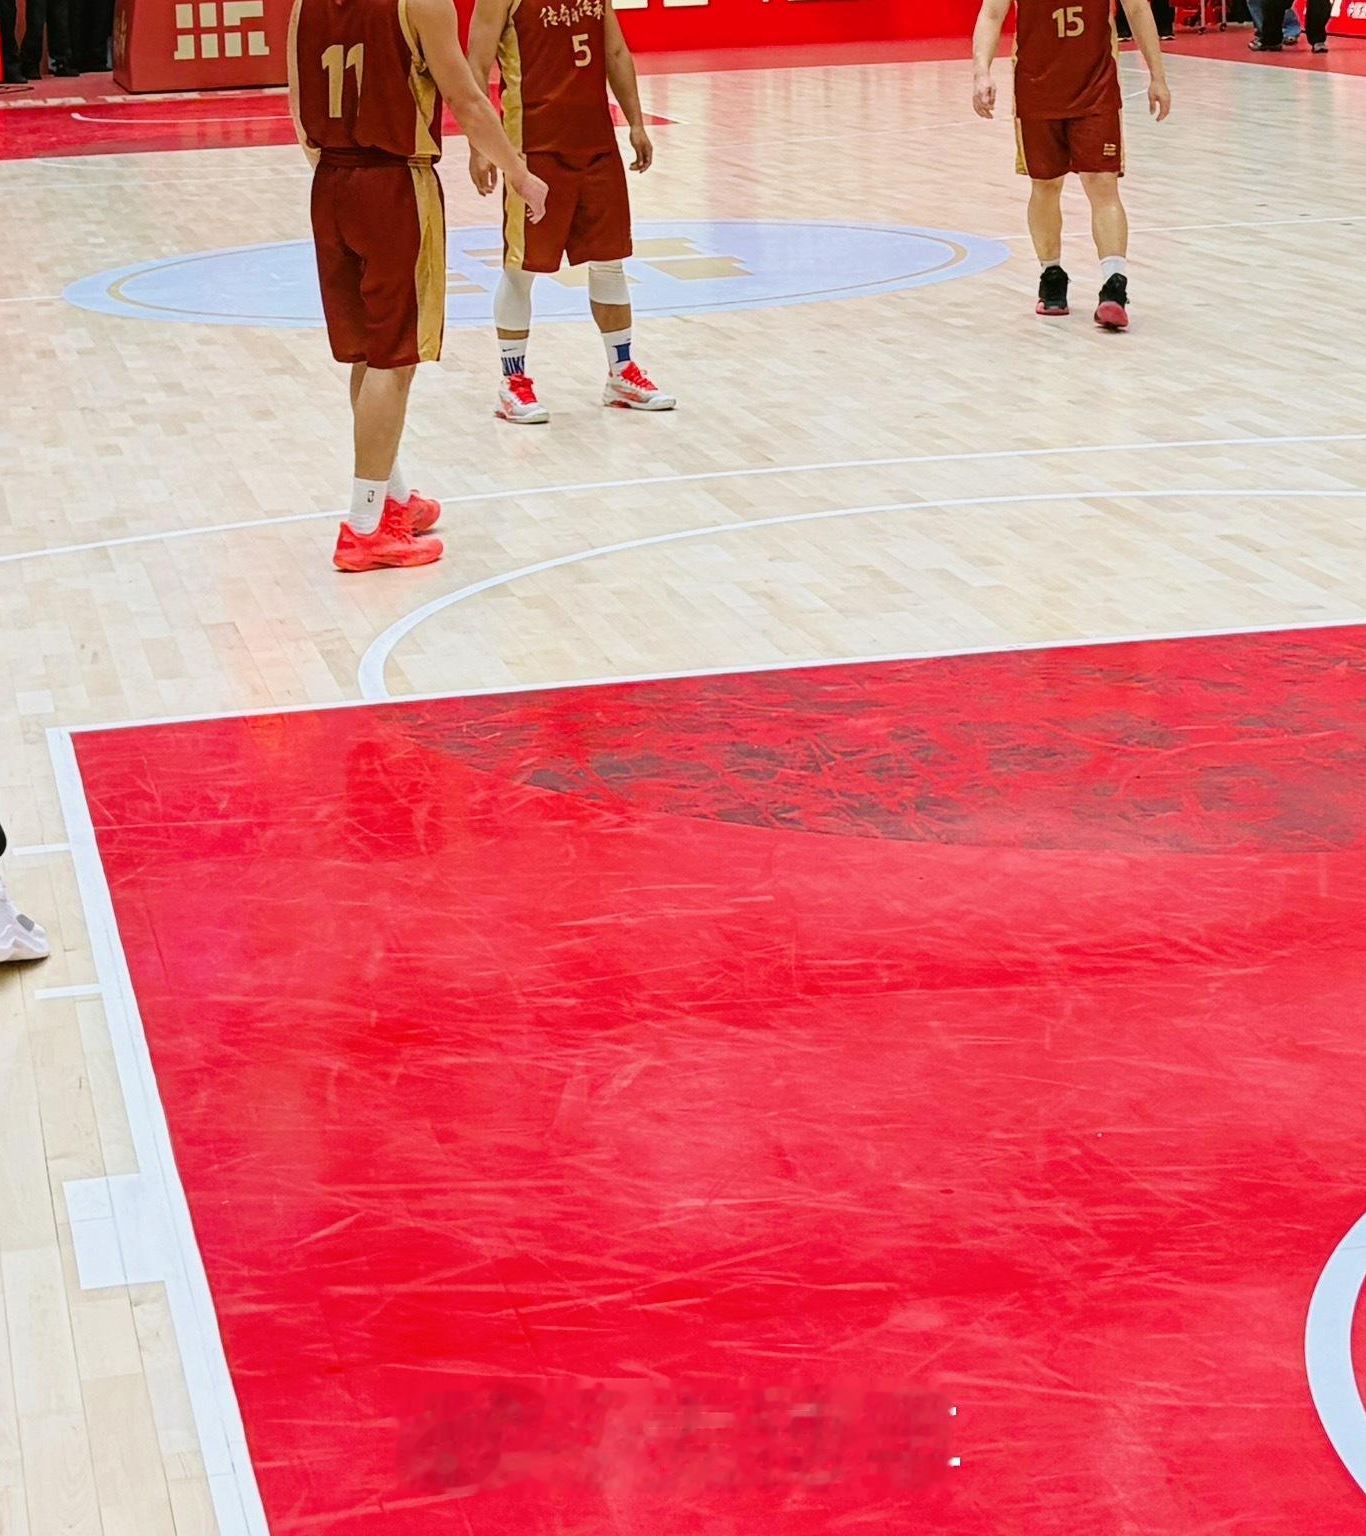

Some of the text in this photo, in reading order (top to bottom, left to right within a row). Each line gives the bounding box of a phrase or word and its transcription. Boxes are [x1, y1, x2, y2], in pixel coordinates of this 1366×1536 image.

[1052, 6, 1084, 38] 15
[572, 33, 592, 67] 5
[322, 42, 364, 119] 11
[501, 356, 525, 376] NIK
